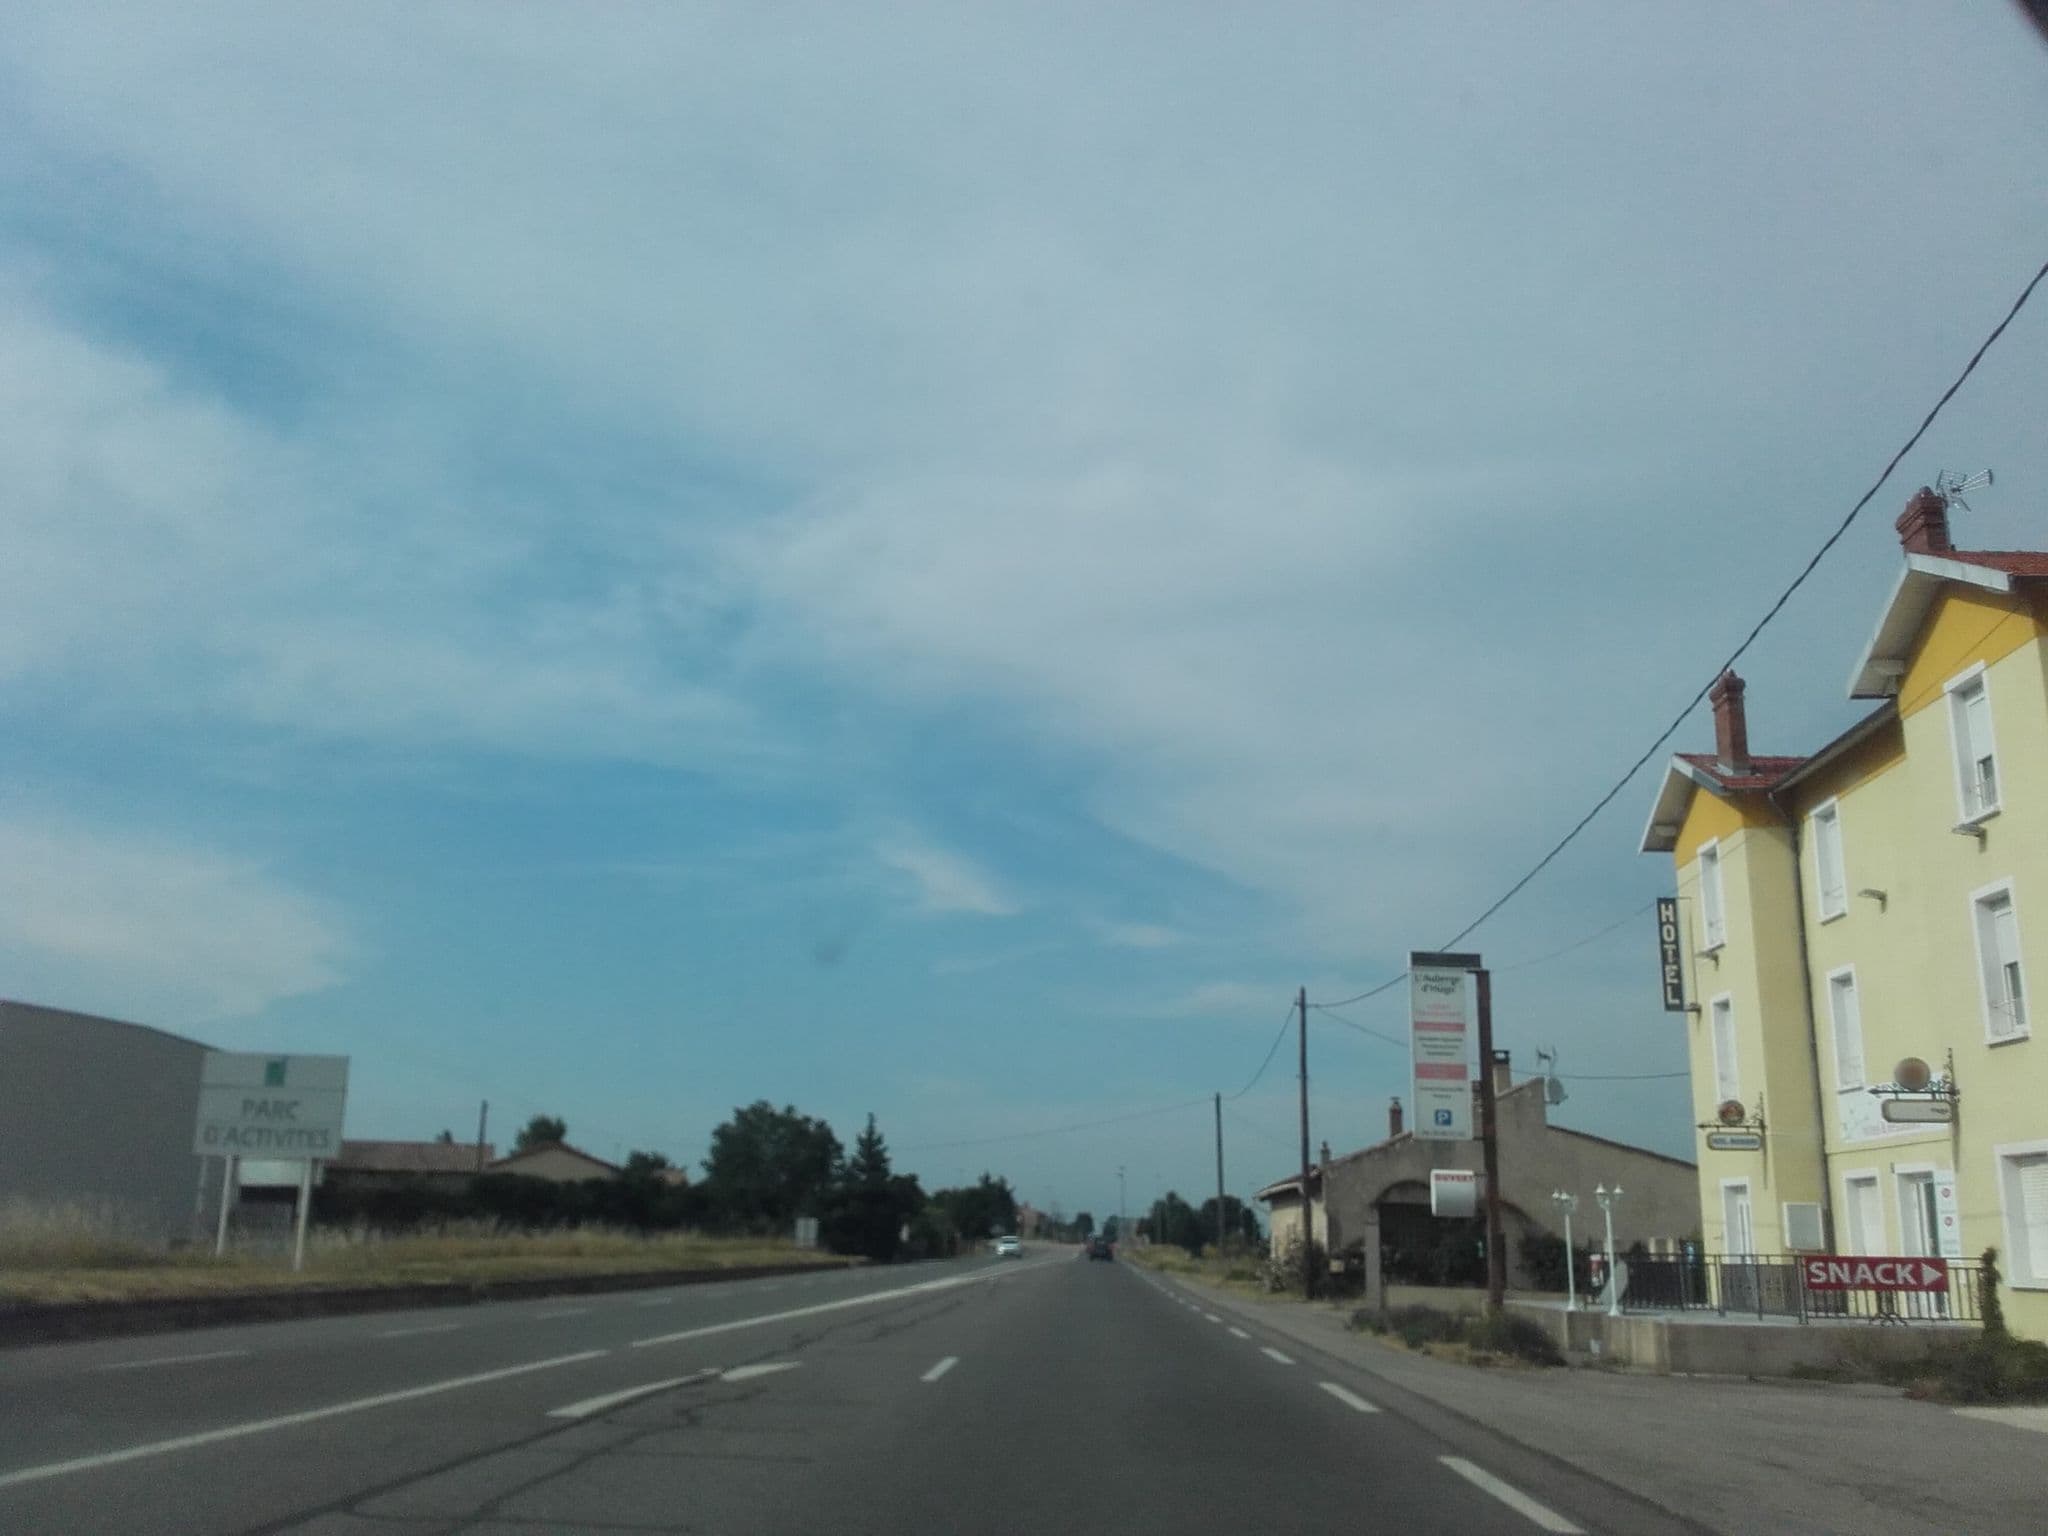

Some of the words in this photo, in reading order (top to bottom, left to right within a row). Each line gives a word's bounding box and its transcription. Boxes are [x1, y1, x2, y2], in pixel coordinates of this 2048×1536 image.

[1660, 903, 1680, 1004] HOTEL
[242, 1099, 299, 1121] PARC
[1808, 1260, 1917, 1286] SNACK
